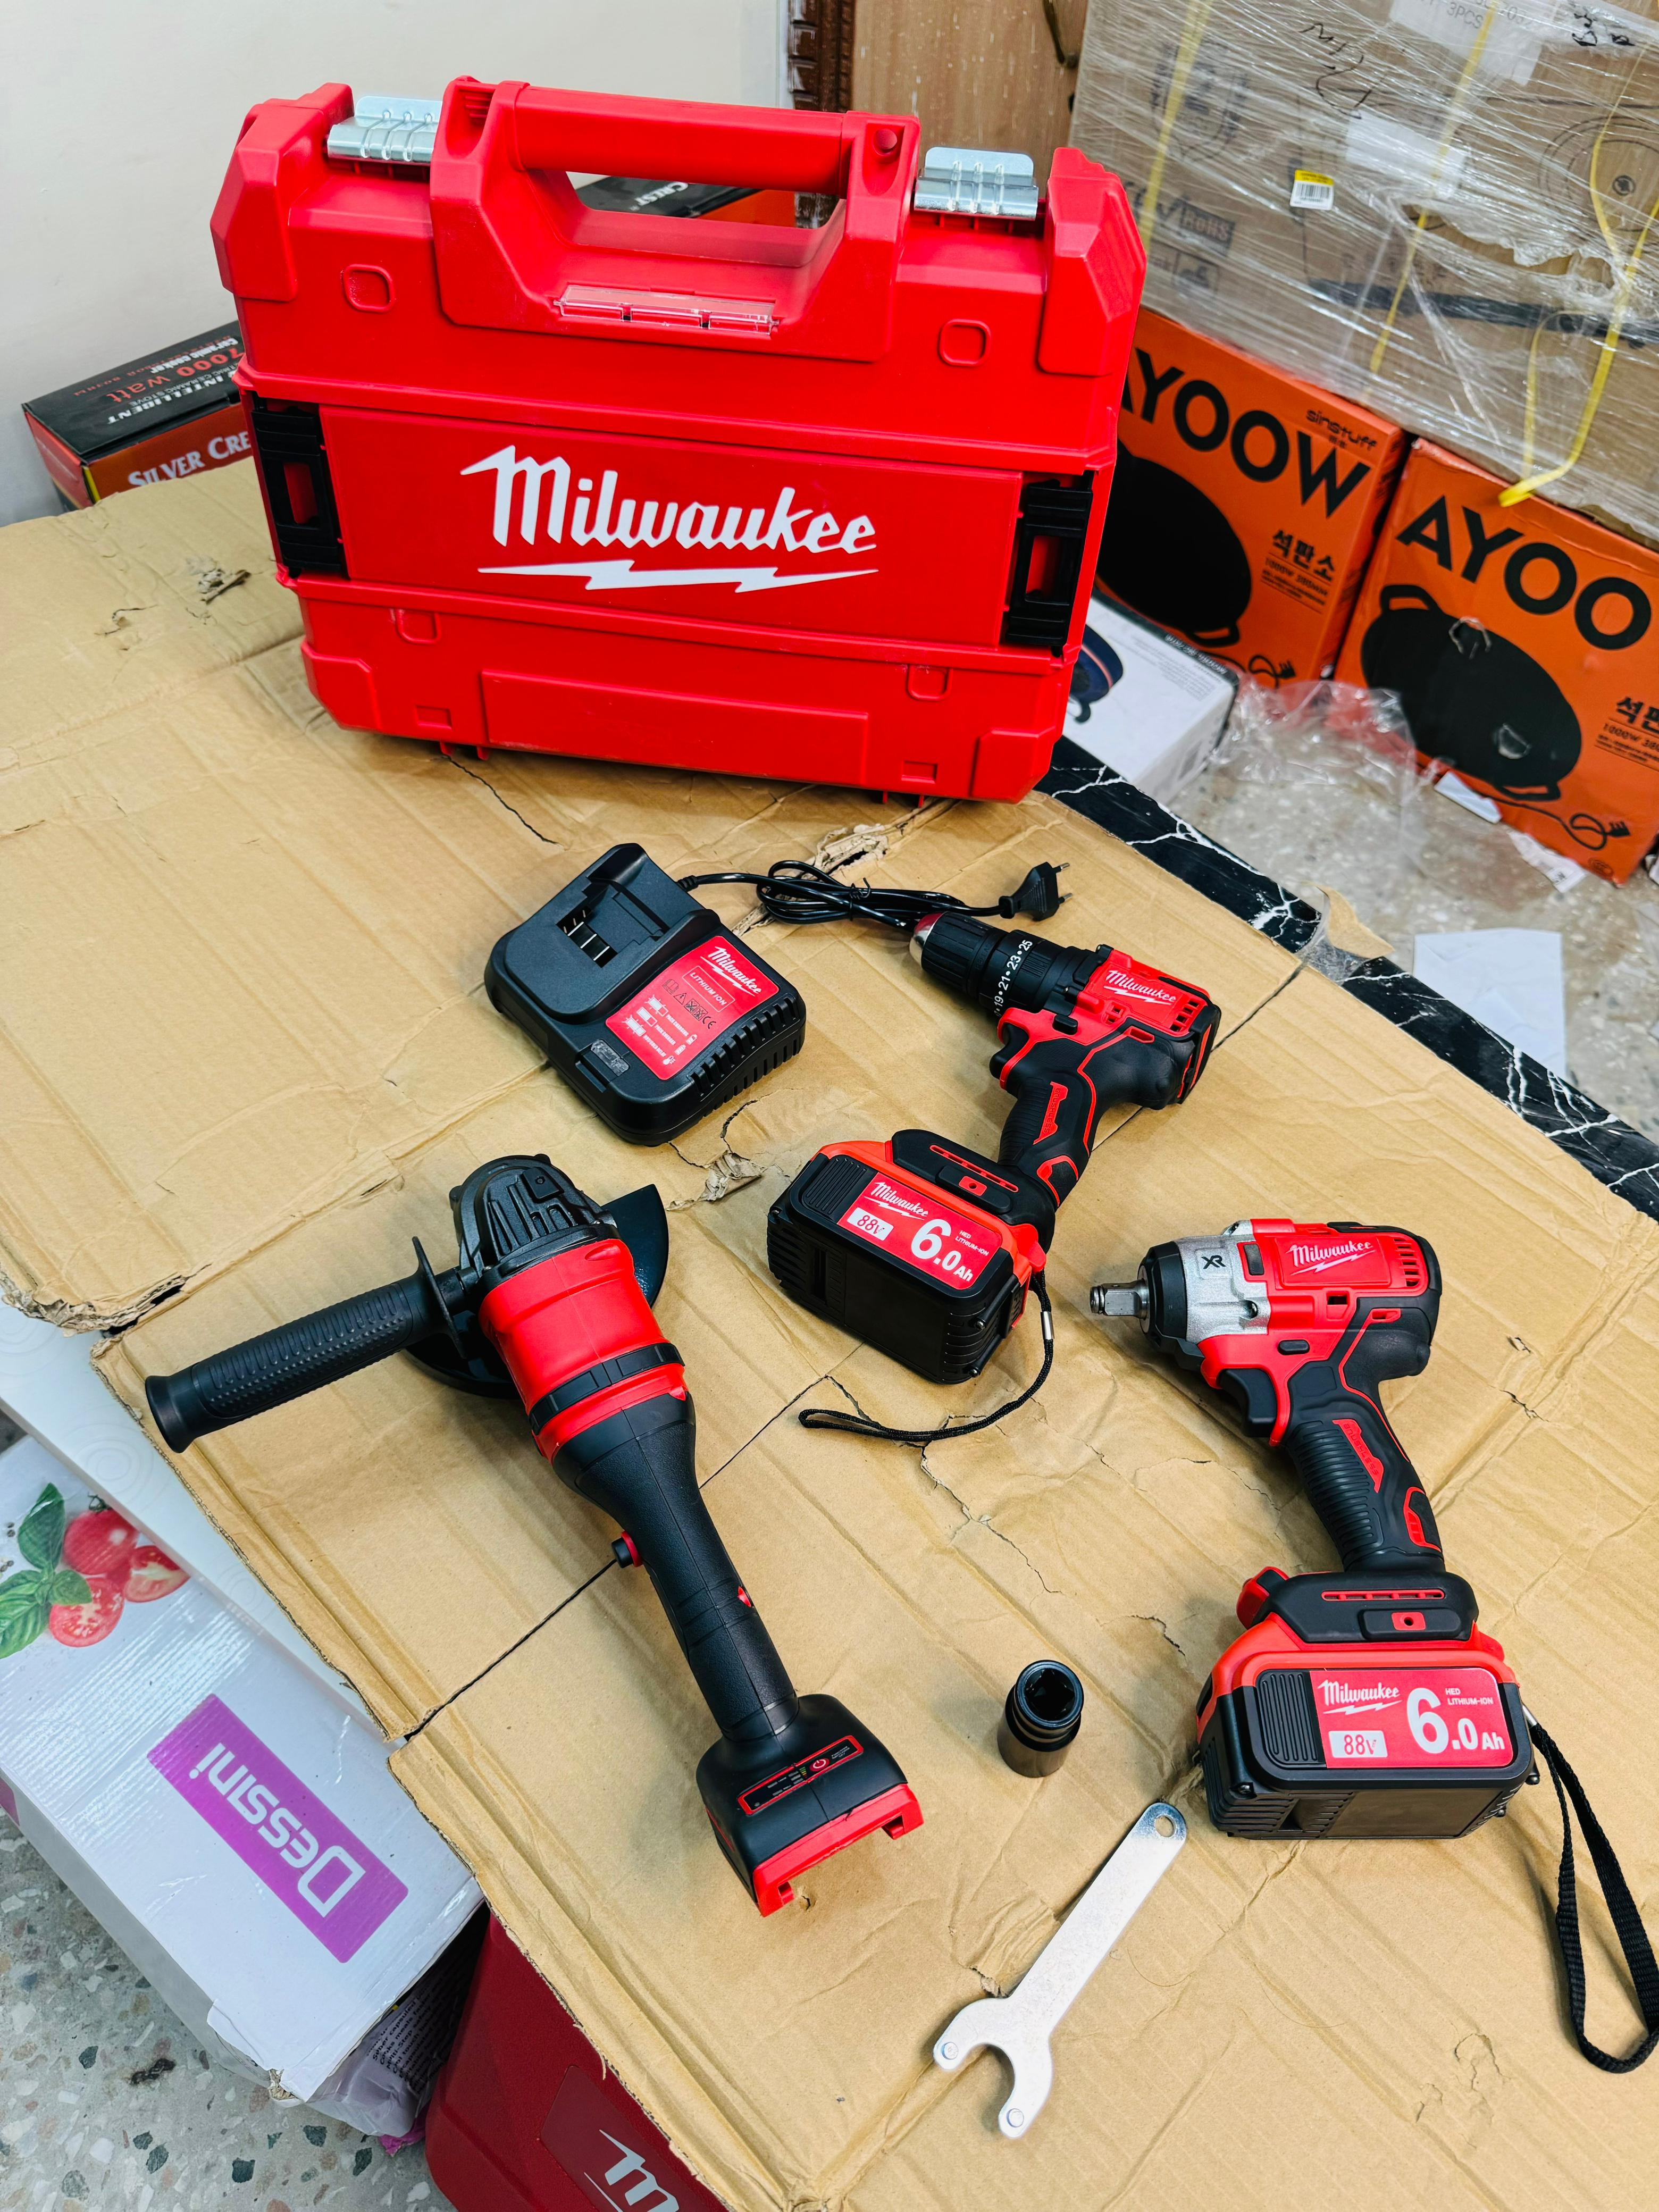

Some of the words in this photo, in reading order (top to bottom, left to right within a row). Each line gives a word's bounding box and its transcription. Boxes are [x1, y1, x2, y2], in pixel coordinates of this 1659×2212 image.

[208, 431, 251, 459] CRE
[1121, 347, 1370, 518] YOOW
[460, 445, 876, 554] Milwaukee
[1021, 940, 1033, 952] 25
[708, 946, 763, 994] Milwaukee
[1007, 954, 1021, 971] 23
[690, 971, 716, 996] LITHIUM
[713, 993, 727, 1006] ION
[998, 974, 1010, 990] 21
[1104, 970, 1177, 1002] Milwaukee
[993, 995, 1004, 1008] 19
[1044, 1088, 1060, 1133] BRUSHLESS
[870, 1182, 928, 1218] Milwaukee
[955, 1235, 990, 1256] LITHIUM-ION
[1286, 1241, 1373, 1267] Milwaukee
[1318, 1680, 1400, 1707] Milwaukee
[1447, 1697, 1494, 1706] LITHIUM-ION
[188, 1742, 366, 1918] Dessini
